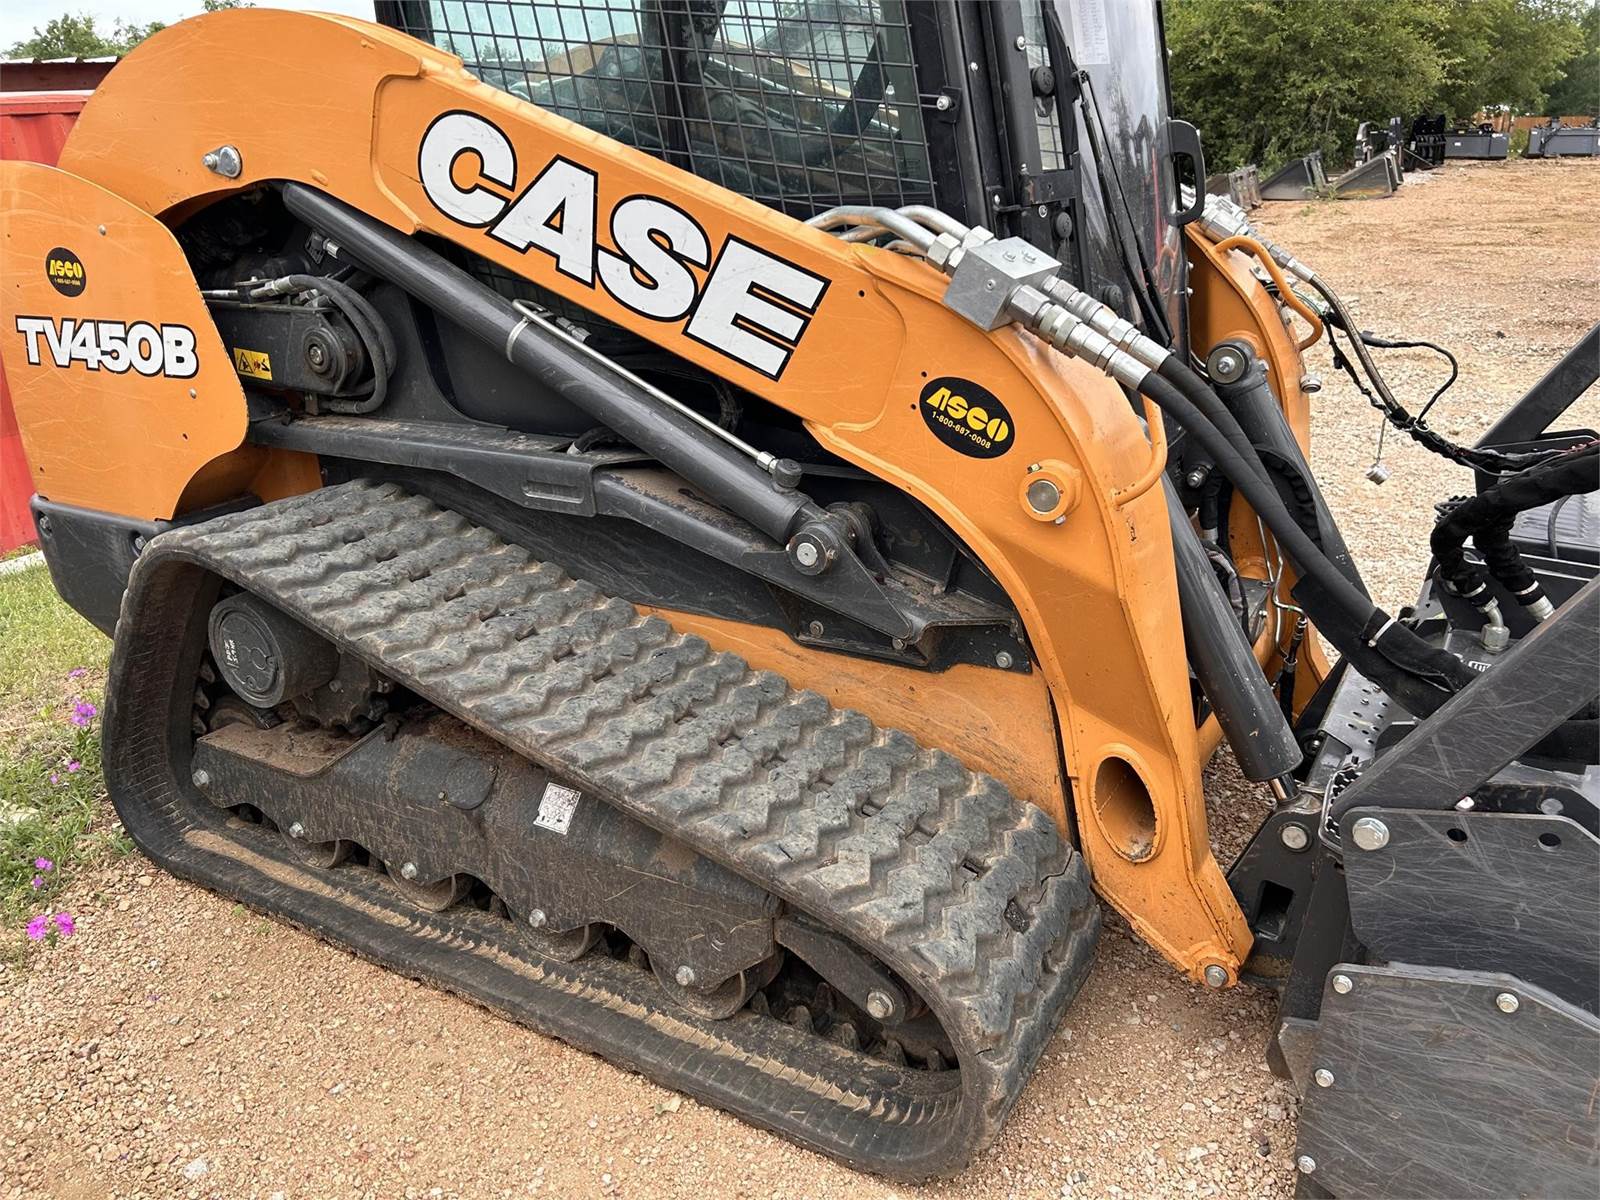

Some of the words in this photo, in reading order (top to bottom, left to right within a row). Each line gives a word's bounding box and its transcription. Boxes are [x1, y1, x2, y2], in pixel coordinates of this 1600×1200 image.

[49, 259, 83, 279] ASCO
[418, 109, 832, 382] CASE
[15, 315, 199, 379] TV450B
[926, 386, 1009, 442] ASCO
[932, 410, 992, 449] 1-800-687-0008
